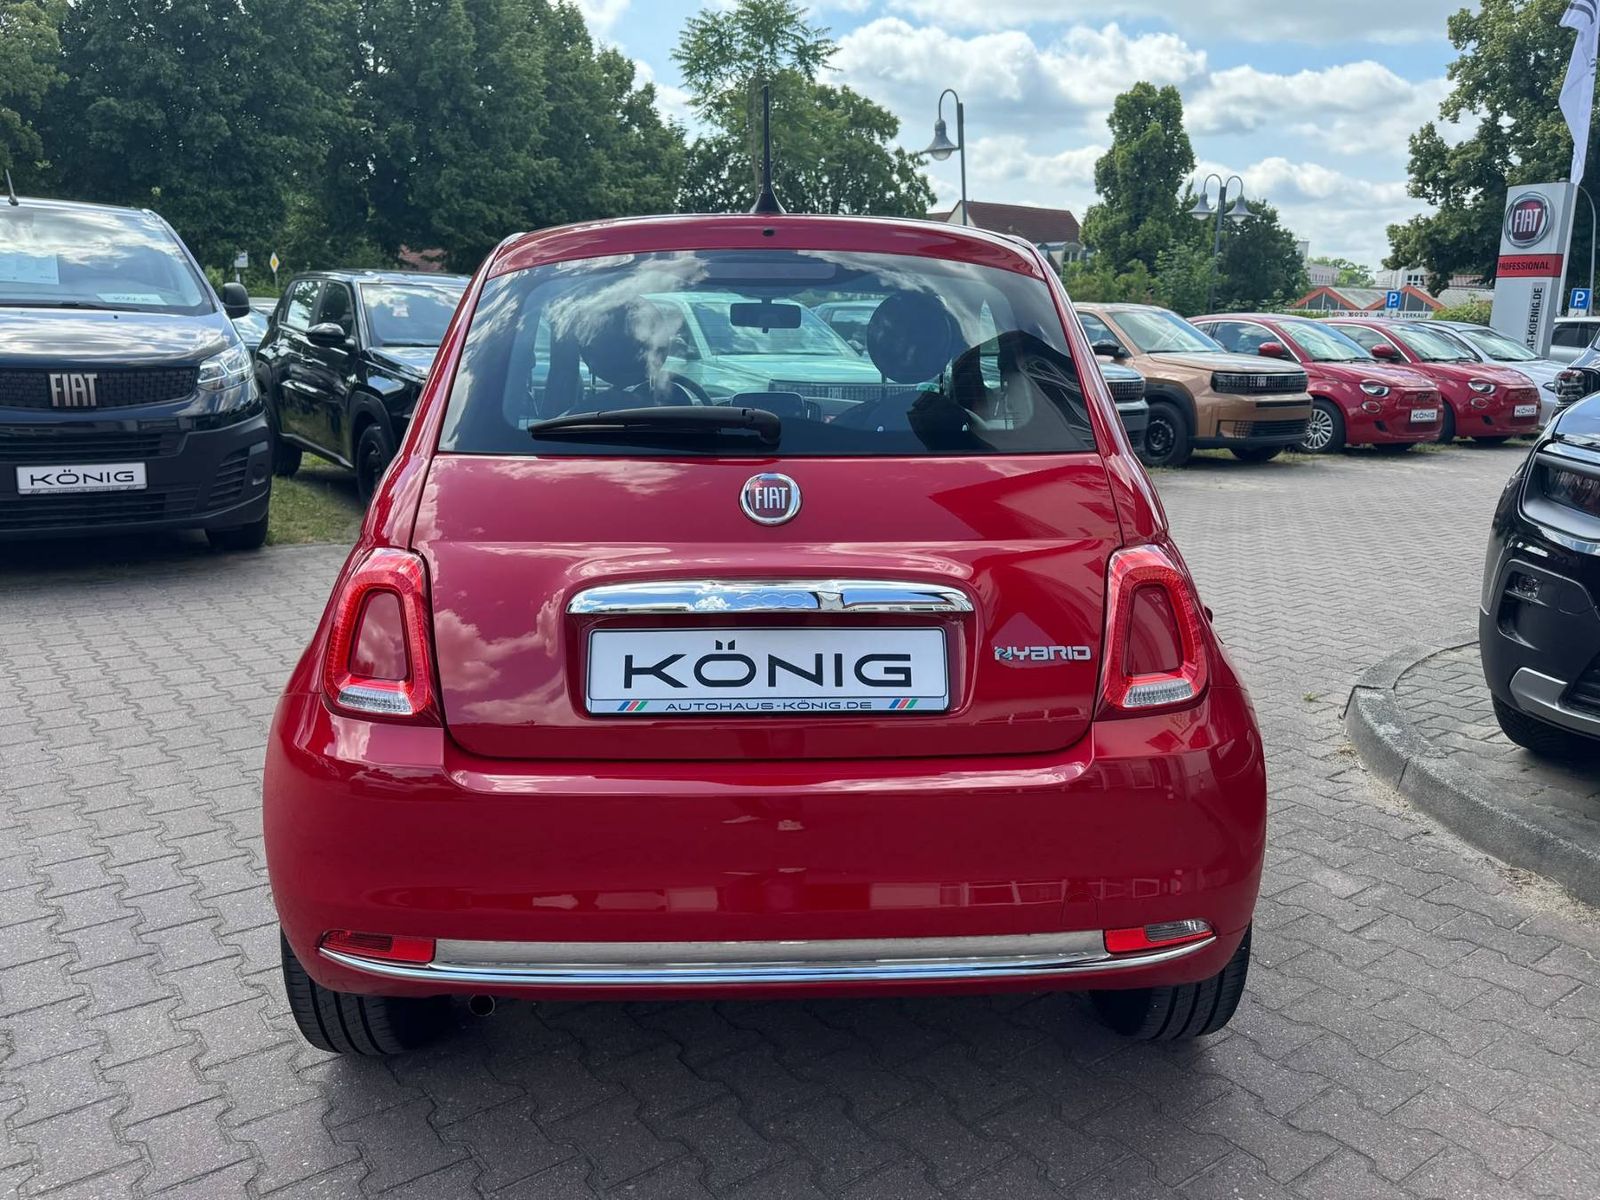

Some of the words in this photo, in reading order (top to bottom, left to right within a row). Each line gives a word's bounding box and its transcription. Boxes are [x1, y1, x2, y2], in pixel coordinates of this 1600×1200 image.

[1513, 208, 1542, 233] FIAT
[1498, 261, 1550, 271] PROFESSIONAL
[1573, 291, 1586, 307] P
[49, 373, 98, 407] FIAT
[30, 469, 134, 486] KÖNIG
[755, 486, 789, 509] FIAT
[994, 645, 1092, 661] HYBRID
[623, 639, 912, 689] KÖNIG
[665, 699, 872, 711] AUTOHAUS-KÖNIG.DE
